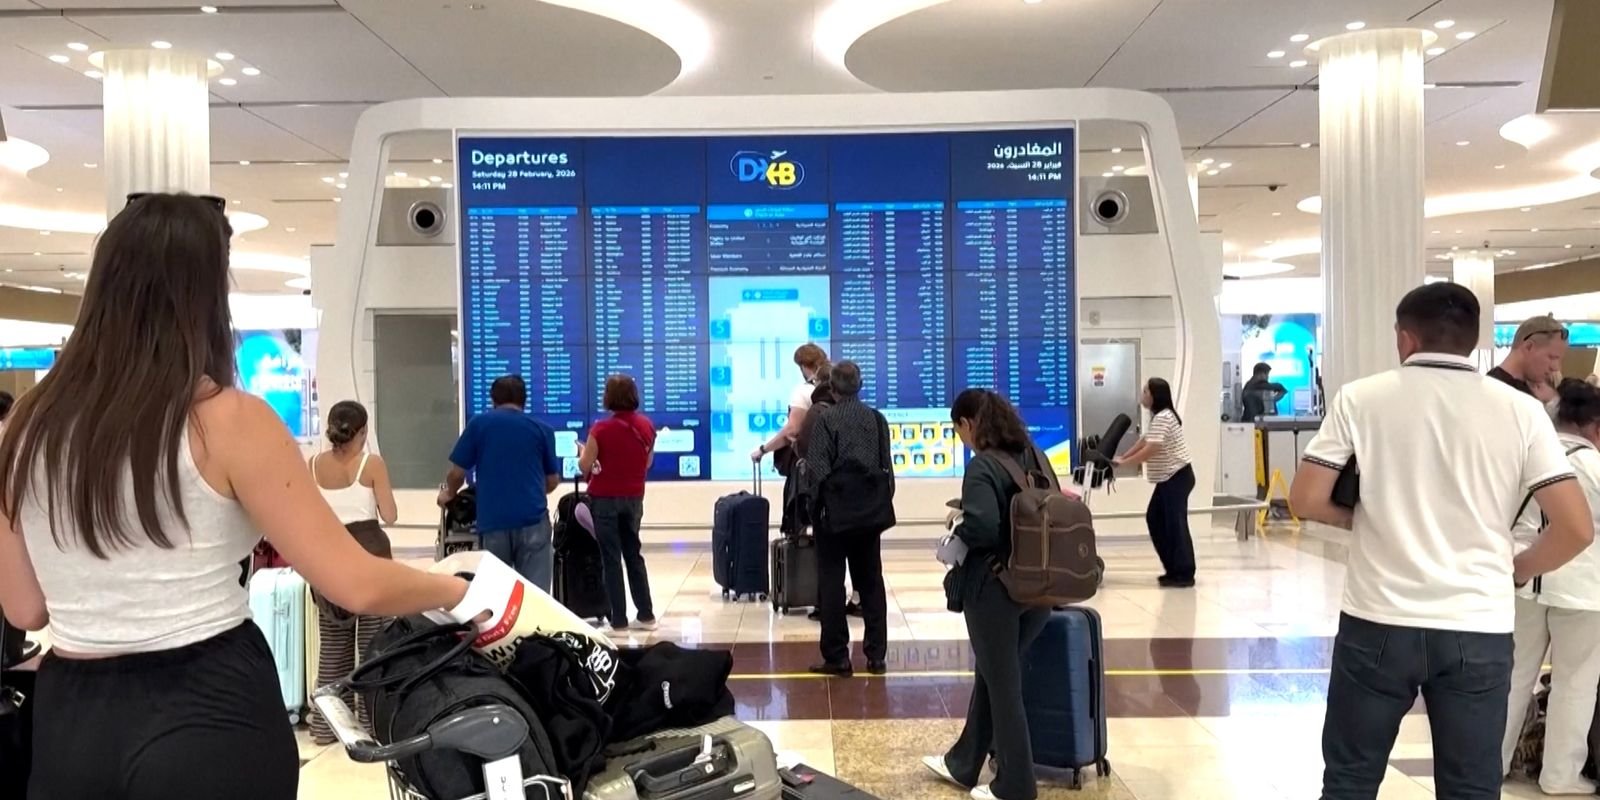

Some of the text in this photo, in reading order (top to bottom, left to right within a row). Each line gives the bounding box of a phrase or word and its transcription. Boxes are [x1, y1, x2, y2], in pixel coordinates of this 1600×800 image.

[993, 141, 1062, 159] المغادرون
[471, 149, 568, 168] Departures
[1032, 161, 1042, 169] 28
[471, 169, 576, 179] Saturday 28 February, 2026
[738, 158, 796, 186] DXB
[1027, 173, 1062, 181] 14:11 PM
[472, 182, 506, 190] 14:11 PM
[716, 321, 725, 334] 5
[814, 319, 824, 332] 6
[717, 367, 725, 381] 3
[719, 414, 725, 427] 1
